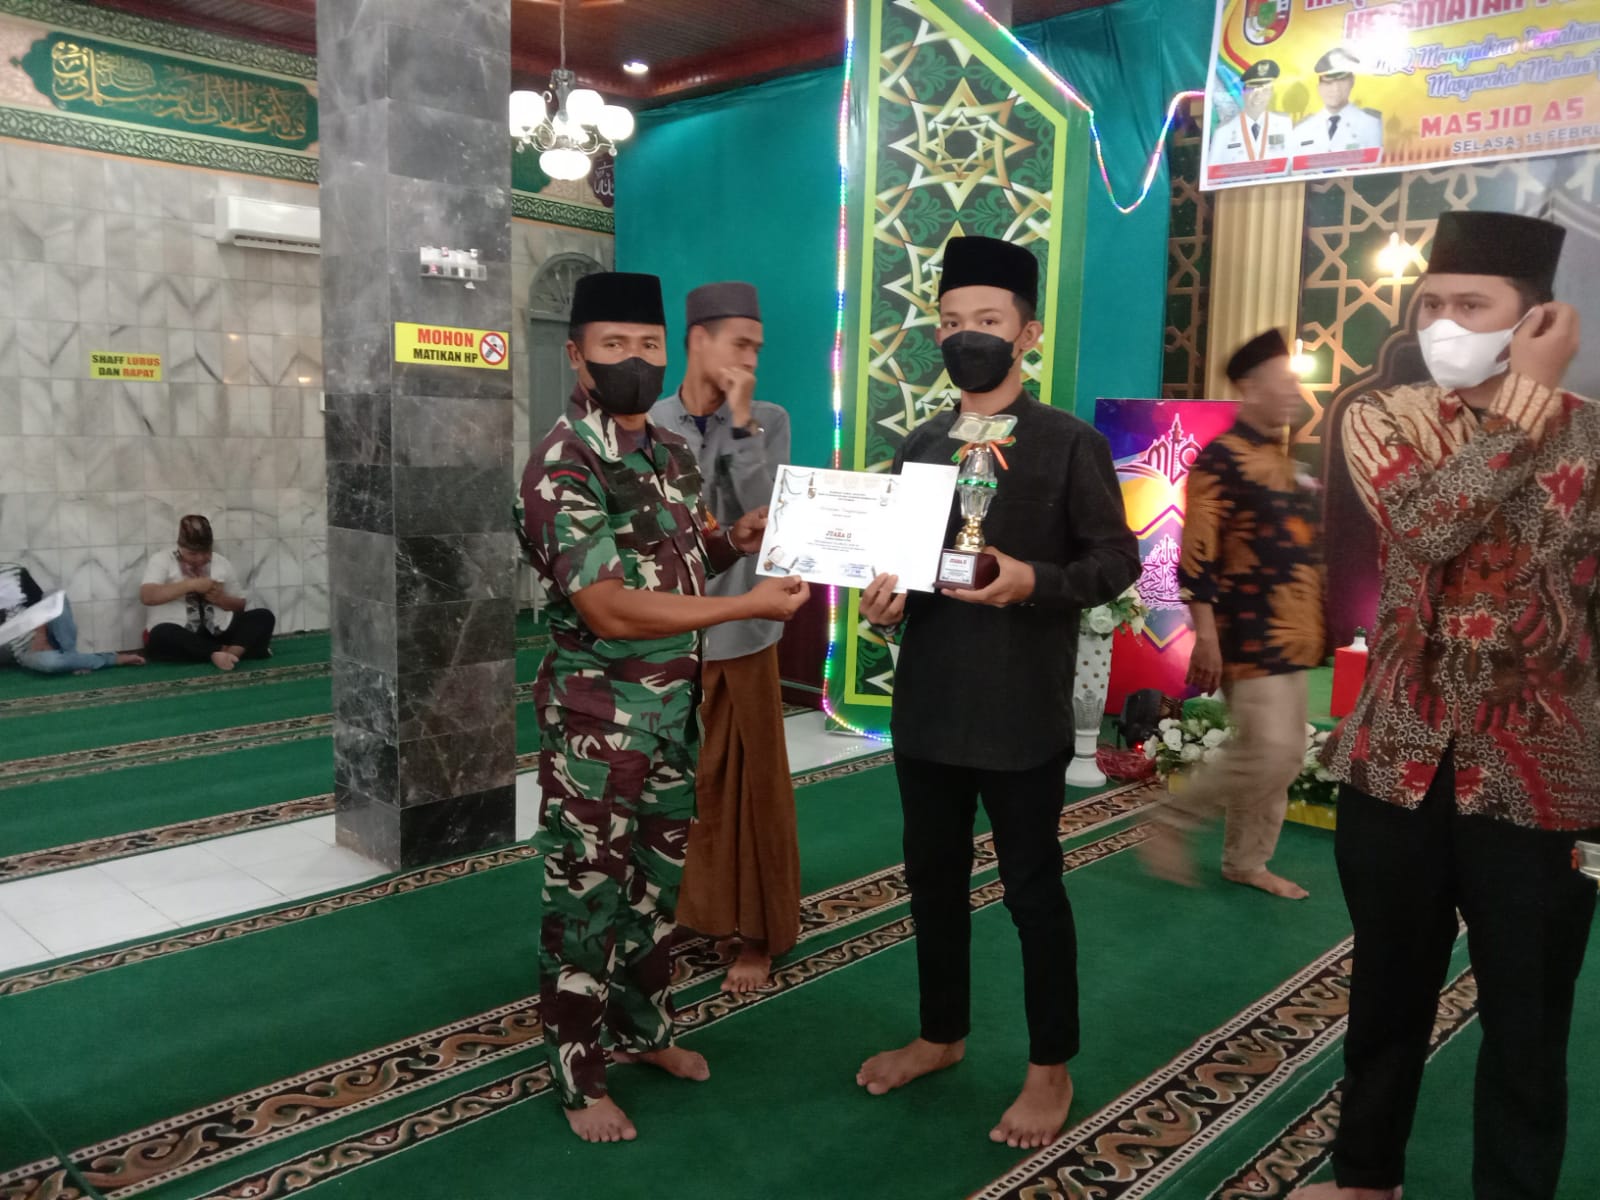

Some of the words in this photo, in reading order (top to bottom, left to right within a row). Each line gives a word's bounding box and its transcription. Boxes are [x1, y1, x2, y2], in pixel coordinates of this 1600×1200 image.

[1421, 104, 1532, 138] MASJID
[1542, 97, 1584, 121] AS
[417, 328, 474, 347] MOHON
[92, 355, 124, 364] SHAFF
[413, 348, 462, 362] MATIKAN
[464, 352, 478, 363] HP
[98, 367, 120, 376] DAN
